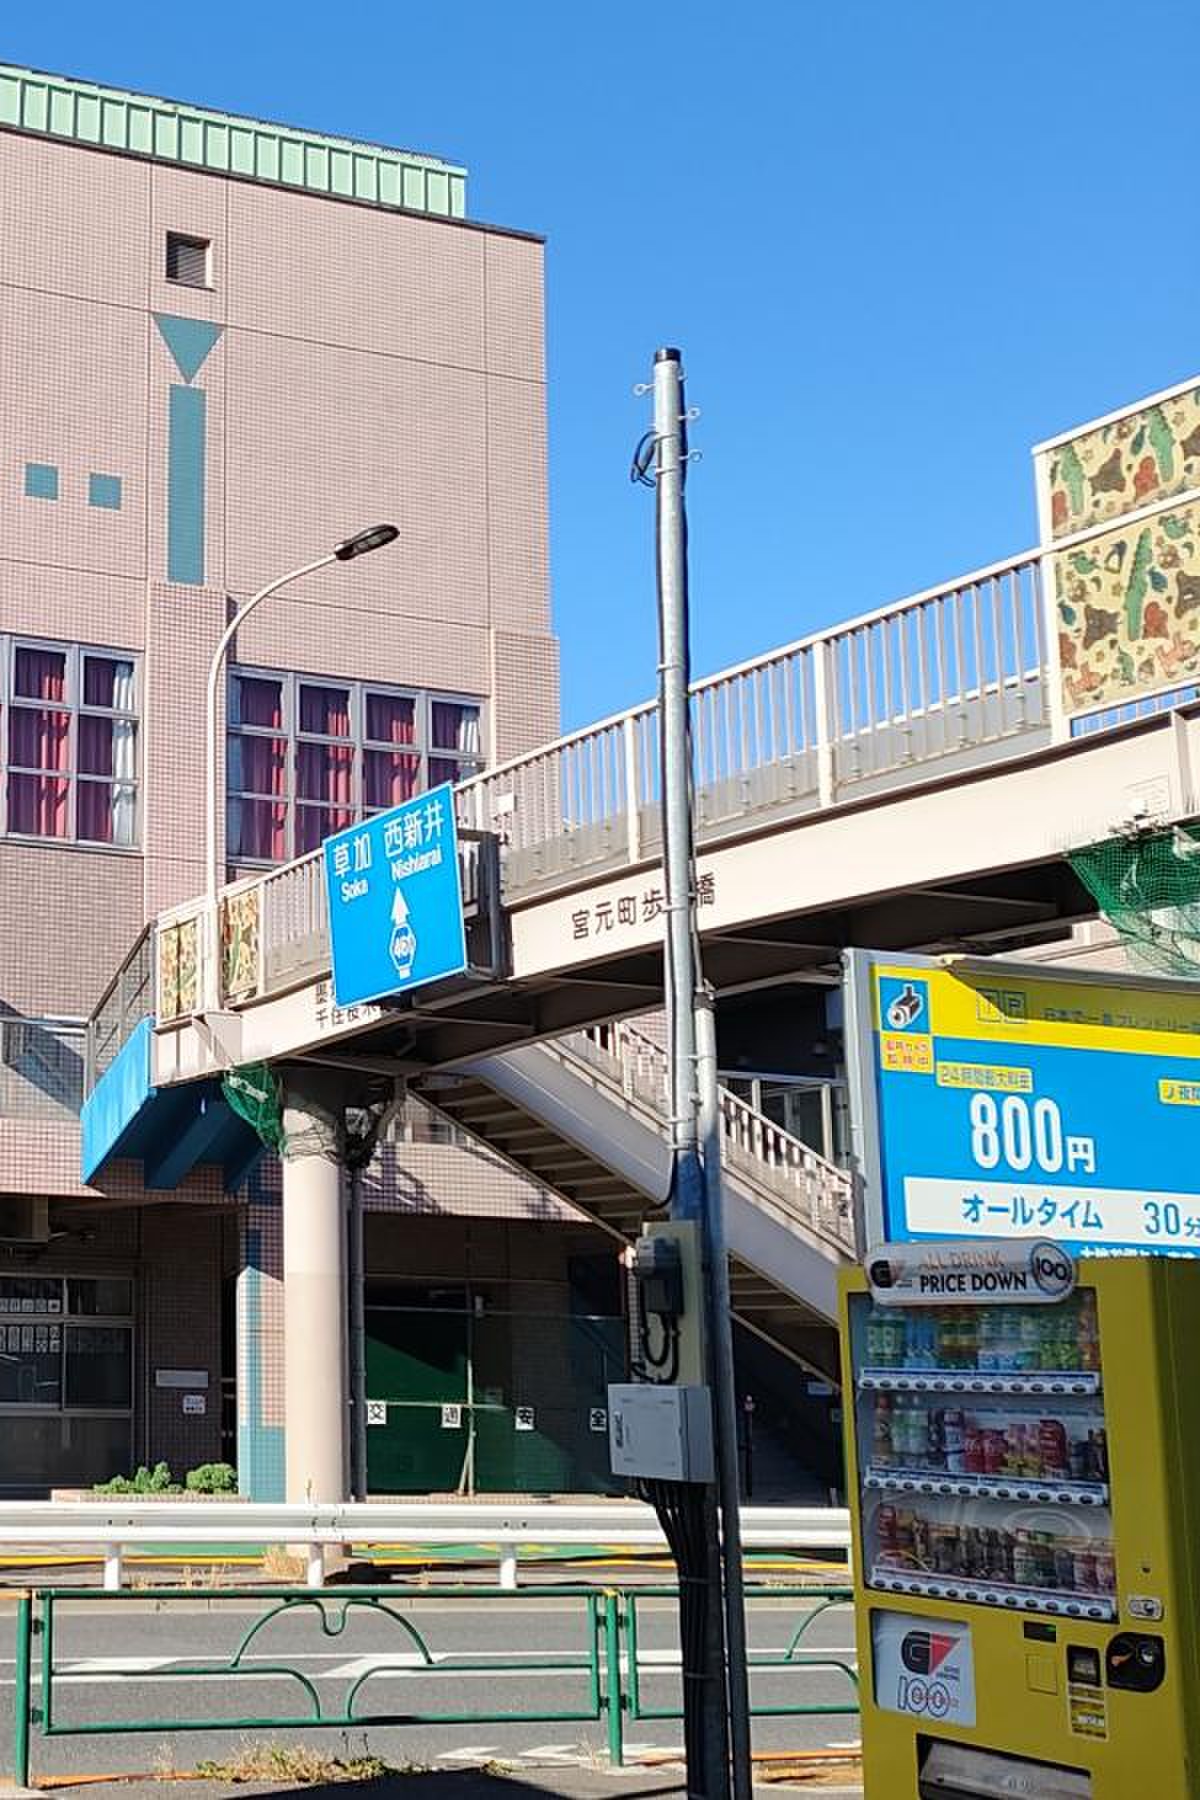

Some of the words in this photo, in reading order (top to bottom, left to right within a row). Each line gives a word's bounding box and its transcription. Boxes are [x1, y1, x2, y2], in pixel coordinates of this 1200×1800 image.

[333, 832, 372, 878] 草加
[383, 799, 443, 858] 西新井
[571, 872, 715, 940] 宮元町歩橋
[969, 1091, 1096, 1173] 800円
[962, 1193, 1103, 1229] オールタイム
[919, 1273, 967, 1293] PRICE
[971, 1271, 1028, 1292] DOWN
[1035, 1256, 1067, 1281] 100
